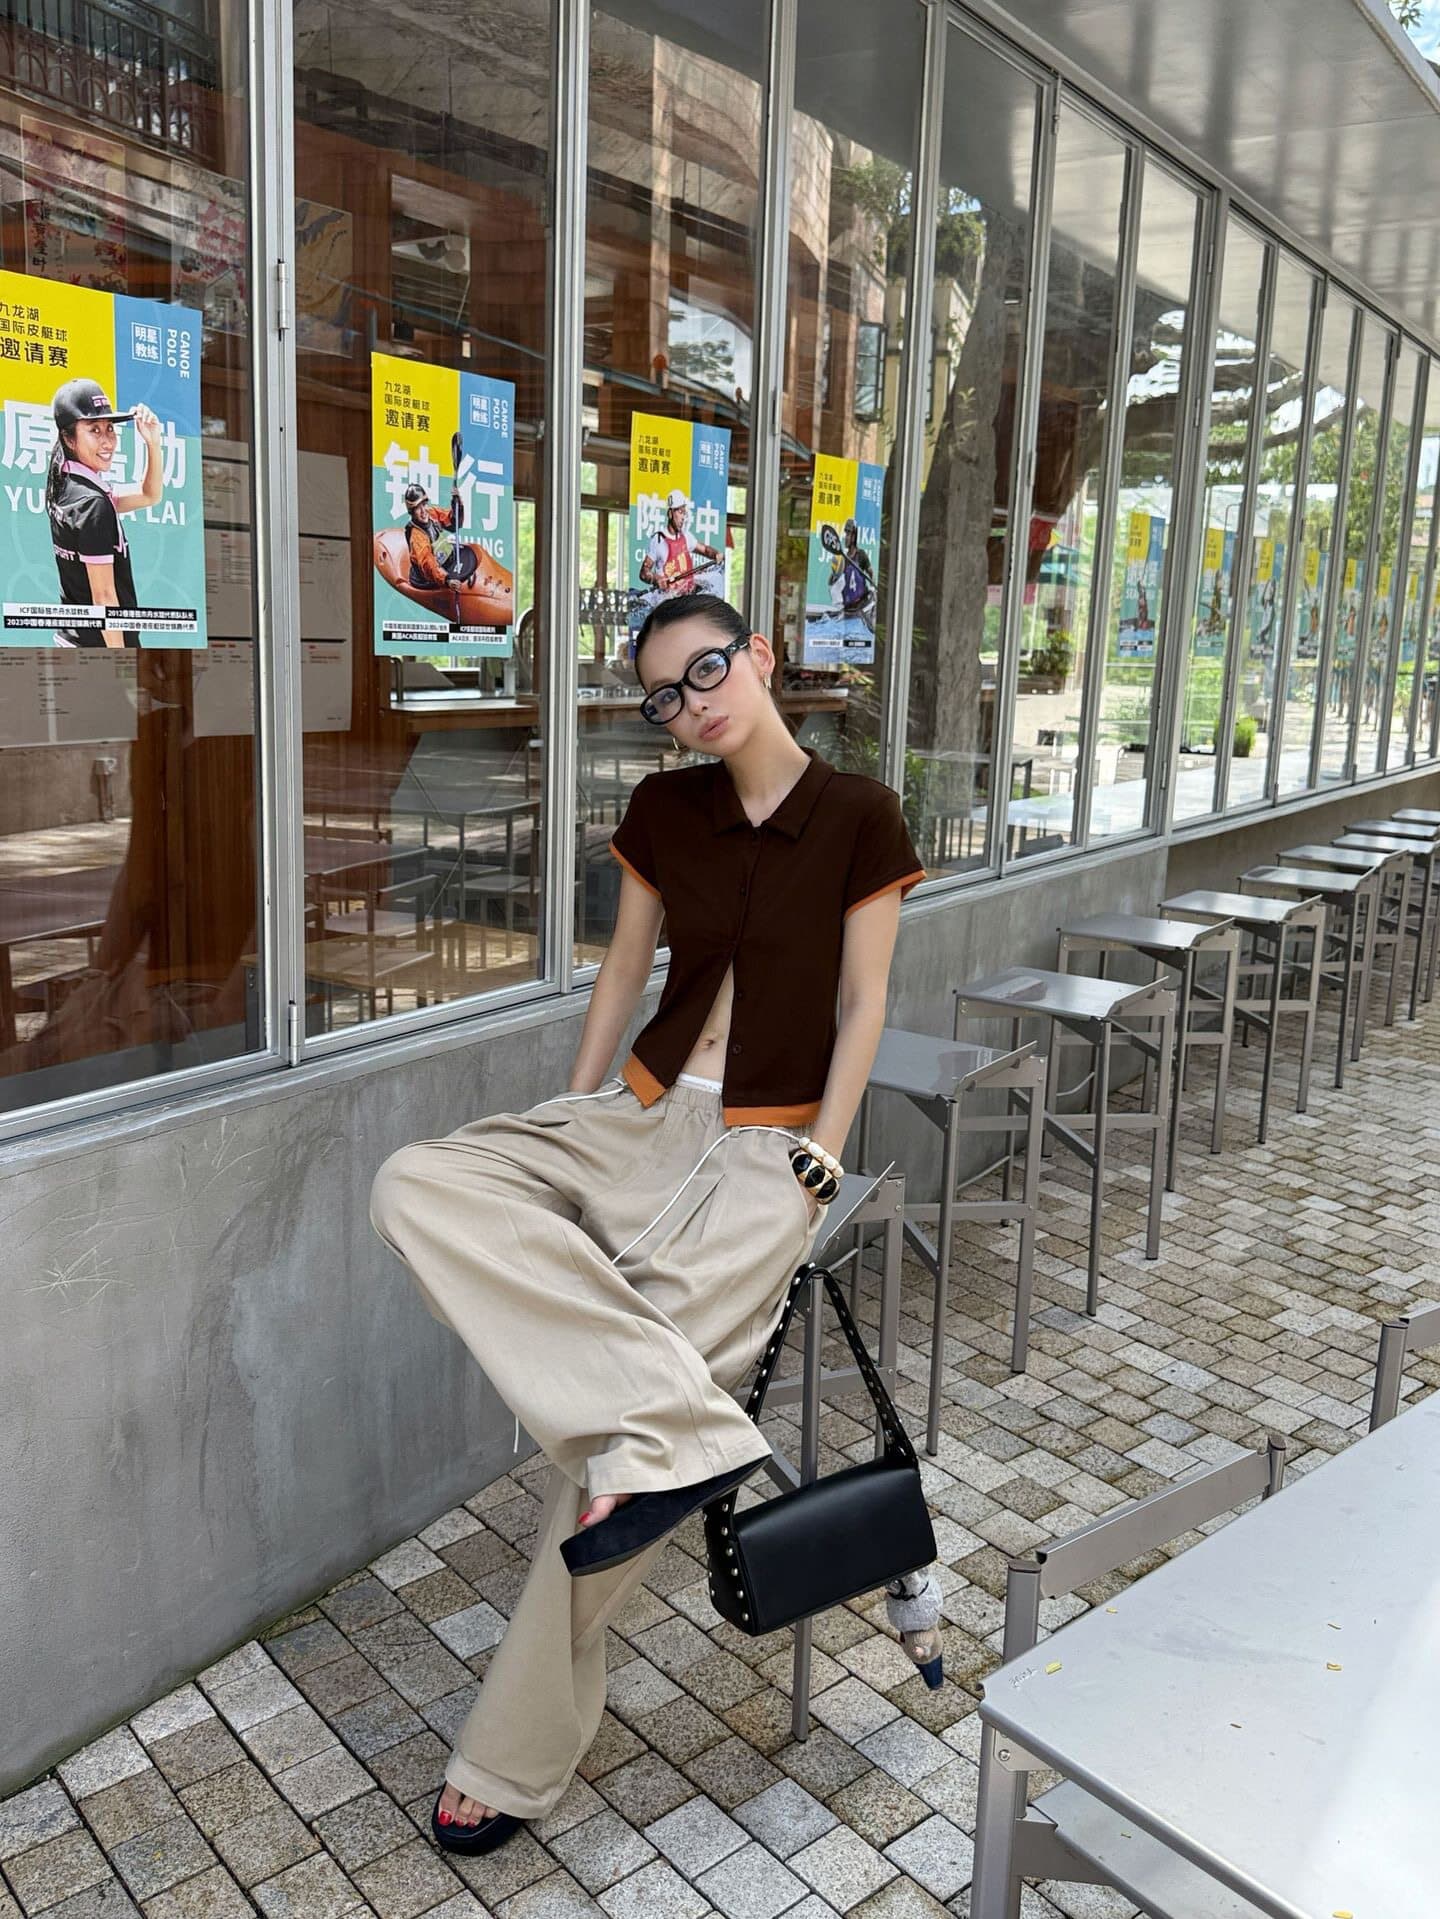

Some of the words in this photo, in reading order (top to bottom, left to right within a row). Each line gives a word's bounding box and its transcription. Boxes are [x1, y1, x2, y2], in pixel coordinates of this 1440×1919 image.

[0, 302, 40, 322] 九龙湖
[0, 317, 68, 342] 国际皮艇球
[0, 337, 68, 369] 邀请赛
[167, 328, 178, 368] POLO
[179, 331, 191, 380] CANOE
[384, 381, 411, 396] 九龙湖
[384, 393, 431, 411] 国际皮艇球
[492, 398, 500, 430] POLO
[385, 408, 431, 433] 邀请赛
[500, 400, 509, 439] CANOE
[638, 457, 672, 476] 邀请赛
